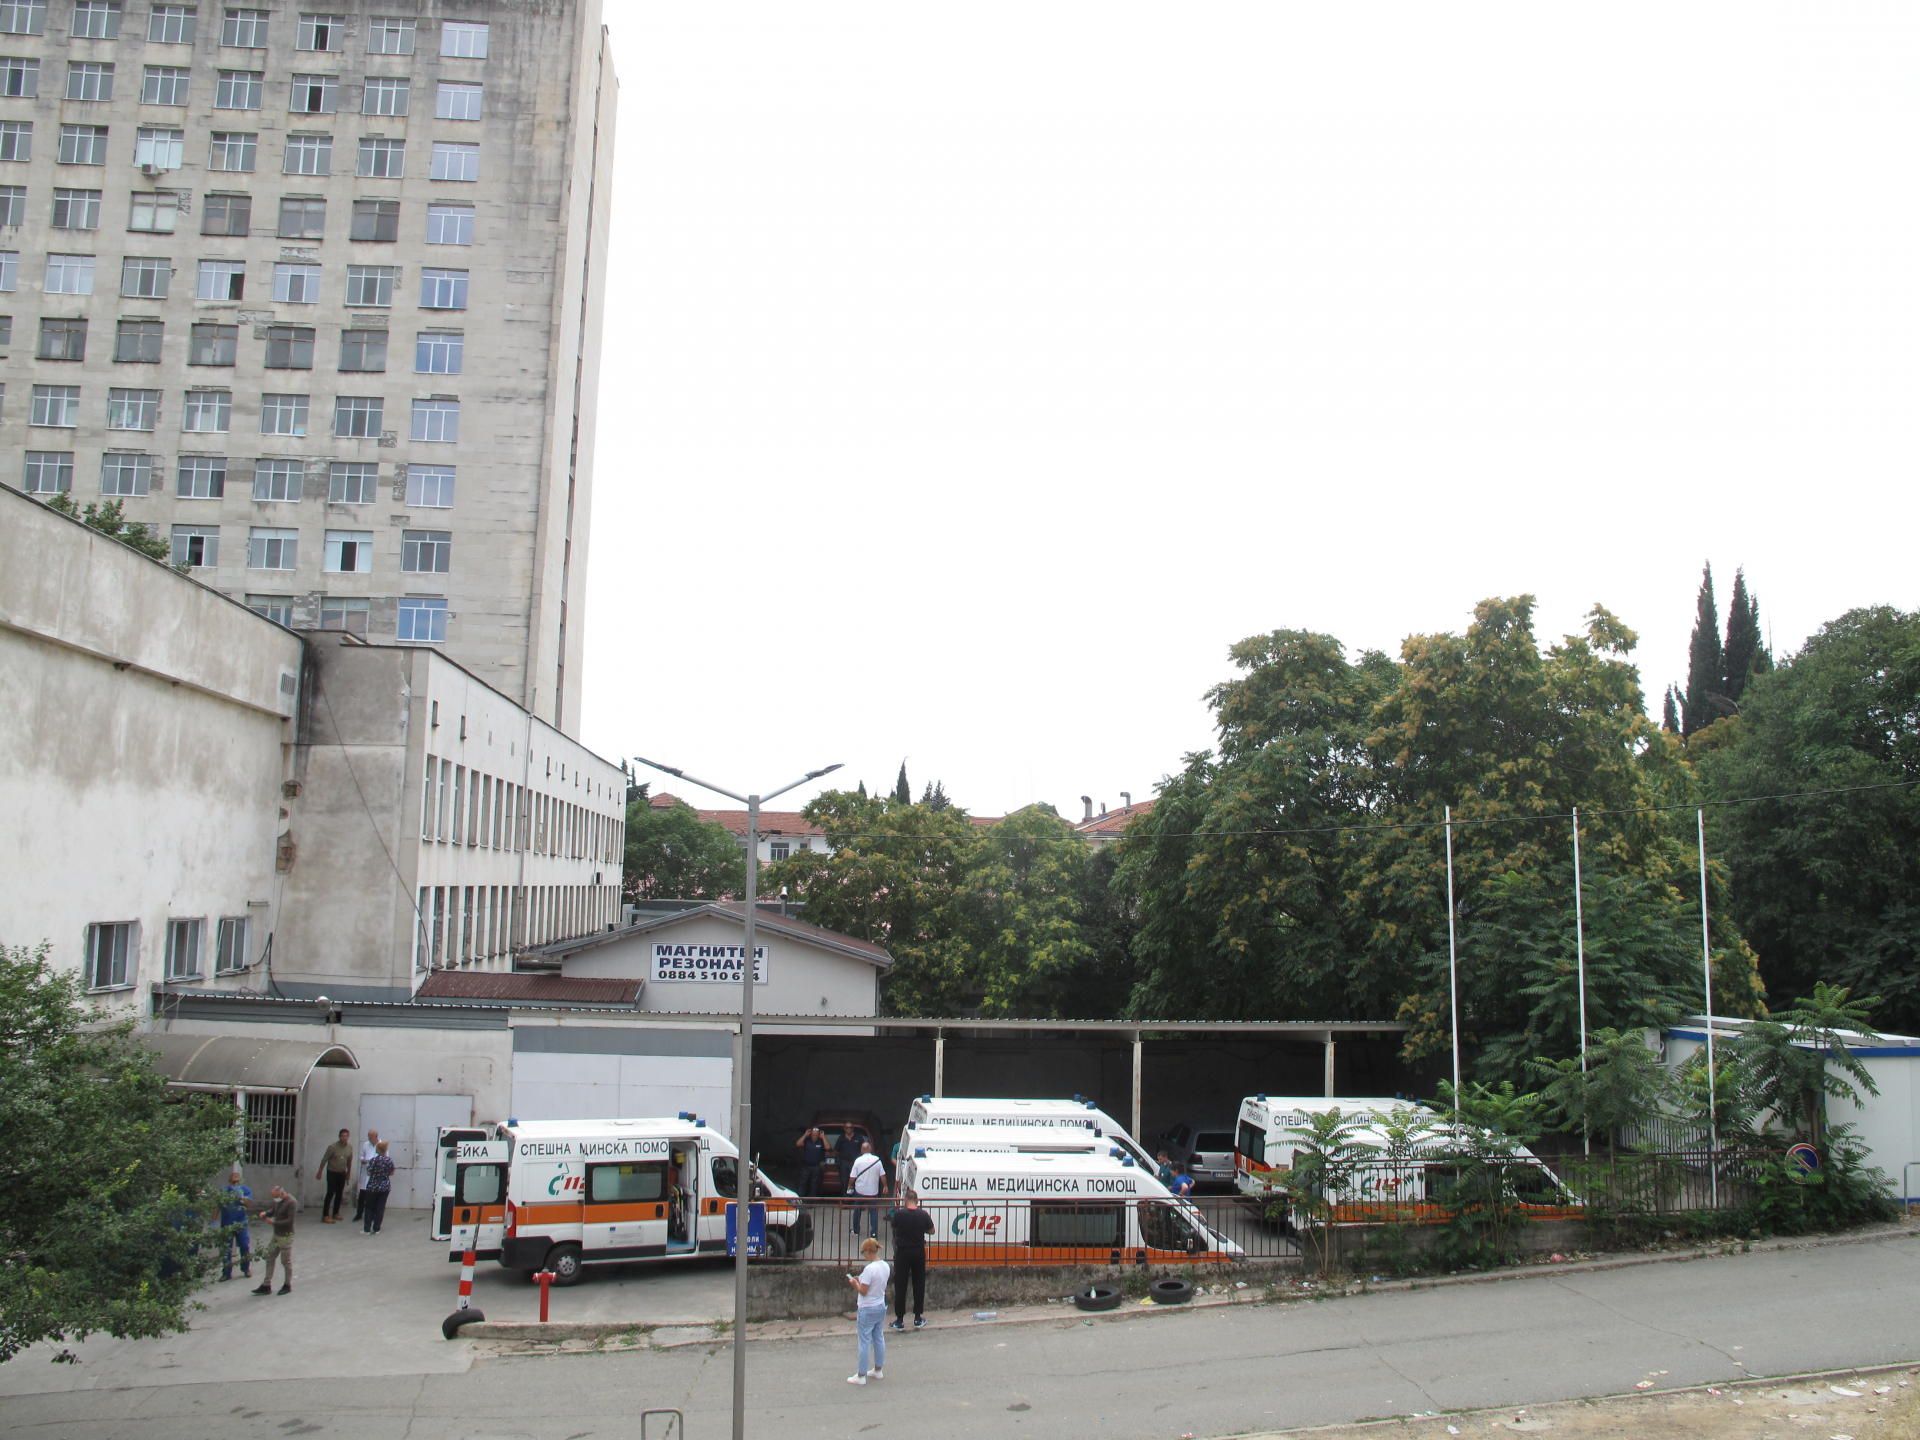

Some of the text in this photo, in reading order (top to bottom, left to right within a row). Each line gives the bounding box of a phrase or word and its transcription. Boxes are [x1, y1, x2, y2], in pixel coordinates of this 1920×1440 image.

[658, 970, 760, 982] 0884 510 64
[520, 1142, 571, 1156] СПЕШНА
[921, 1176, 1137, 1194] СПЕШНА МЕДИЦИНСКА ПОМОЩ
[968, 1215, 1001, 1230] 112
